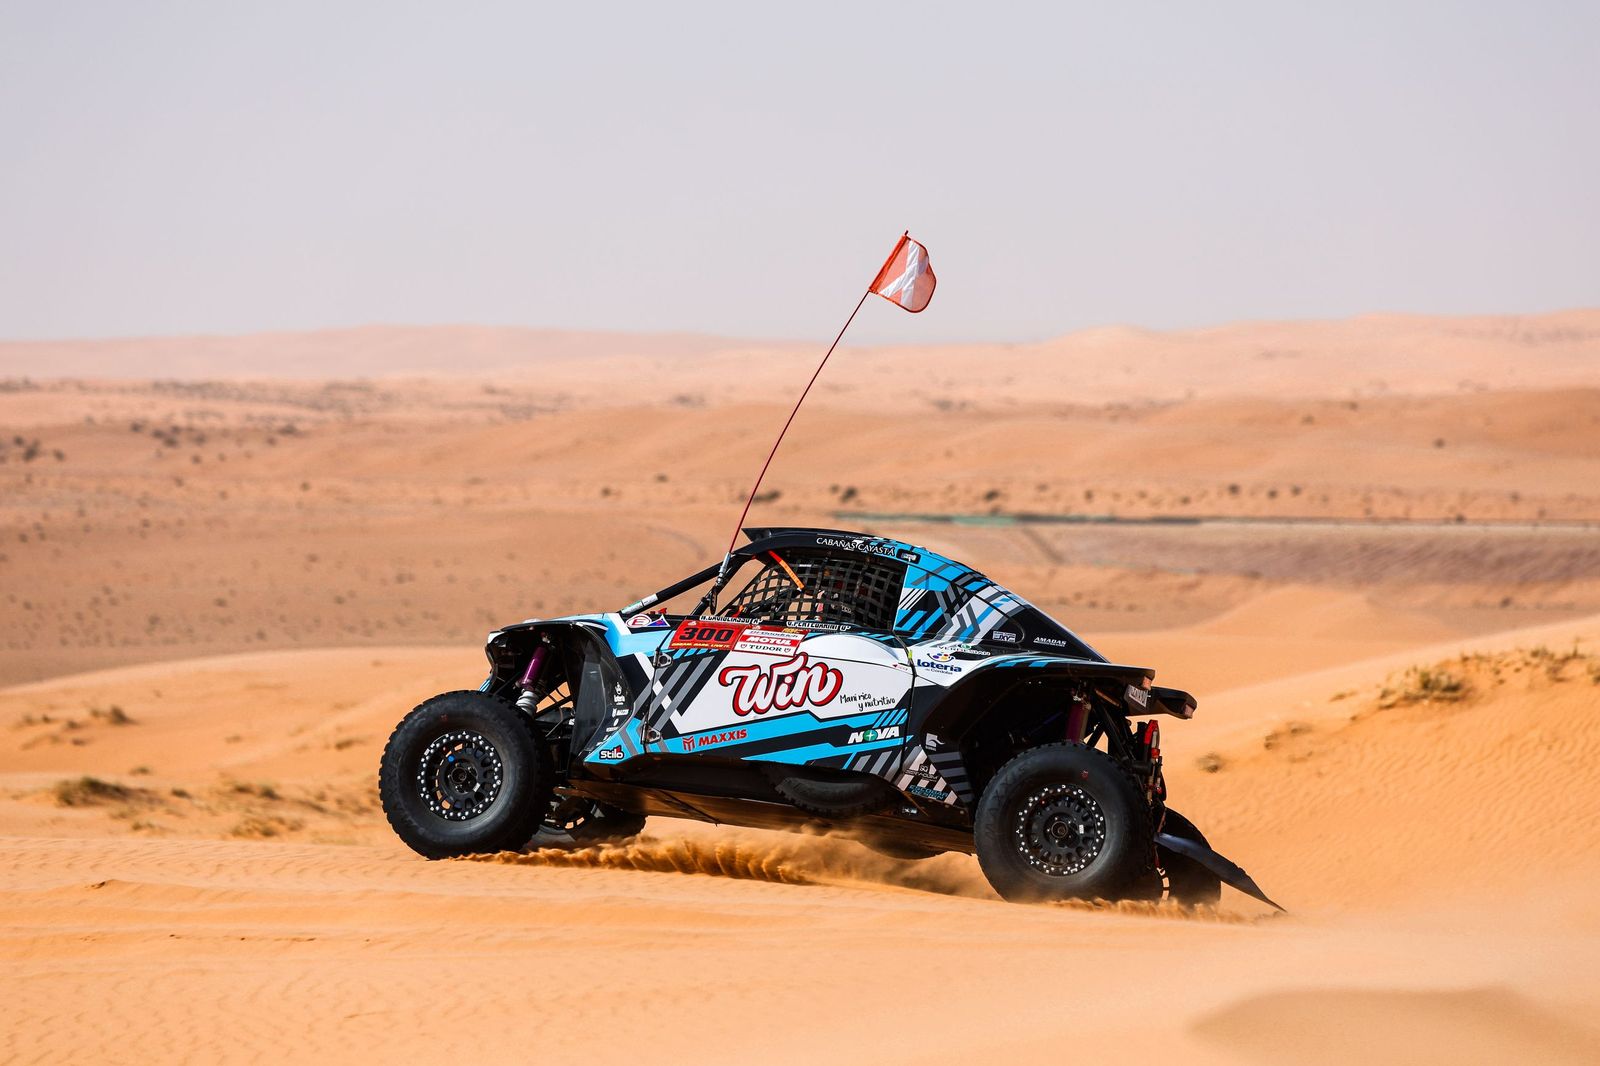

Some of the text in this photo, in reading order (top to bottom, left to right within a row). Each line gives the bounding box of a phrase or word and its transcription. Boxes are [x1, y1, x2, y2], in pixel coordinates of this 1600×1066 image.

[816, 537, 856, 549] CABAÑAS
[678, 627, 735, 642] 300
[746, 636, 792, 646] MOTUL
[749, 644, 783, 652] TUDOR
[718, 653, 843, 716] Win
[858, 692, 872, 700] rico
[858, 696, 896, 712] y nutritivo
[698, 729, 747, 746] MAXXIS
[600, 747, 624, 759] Stilo
